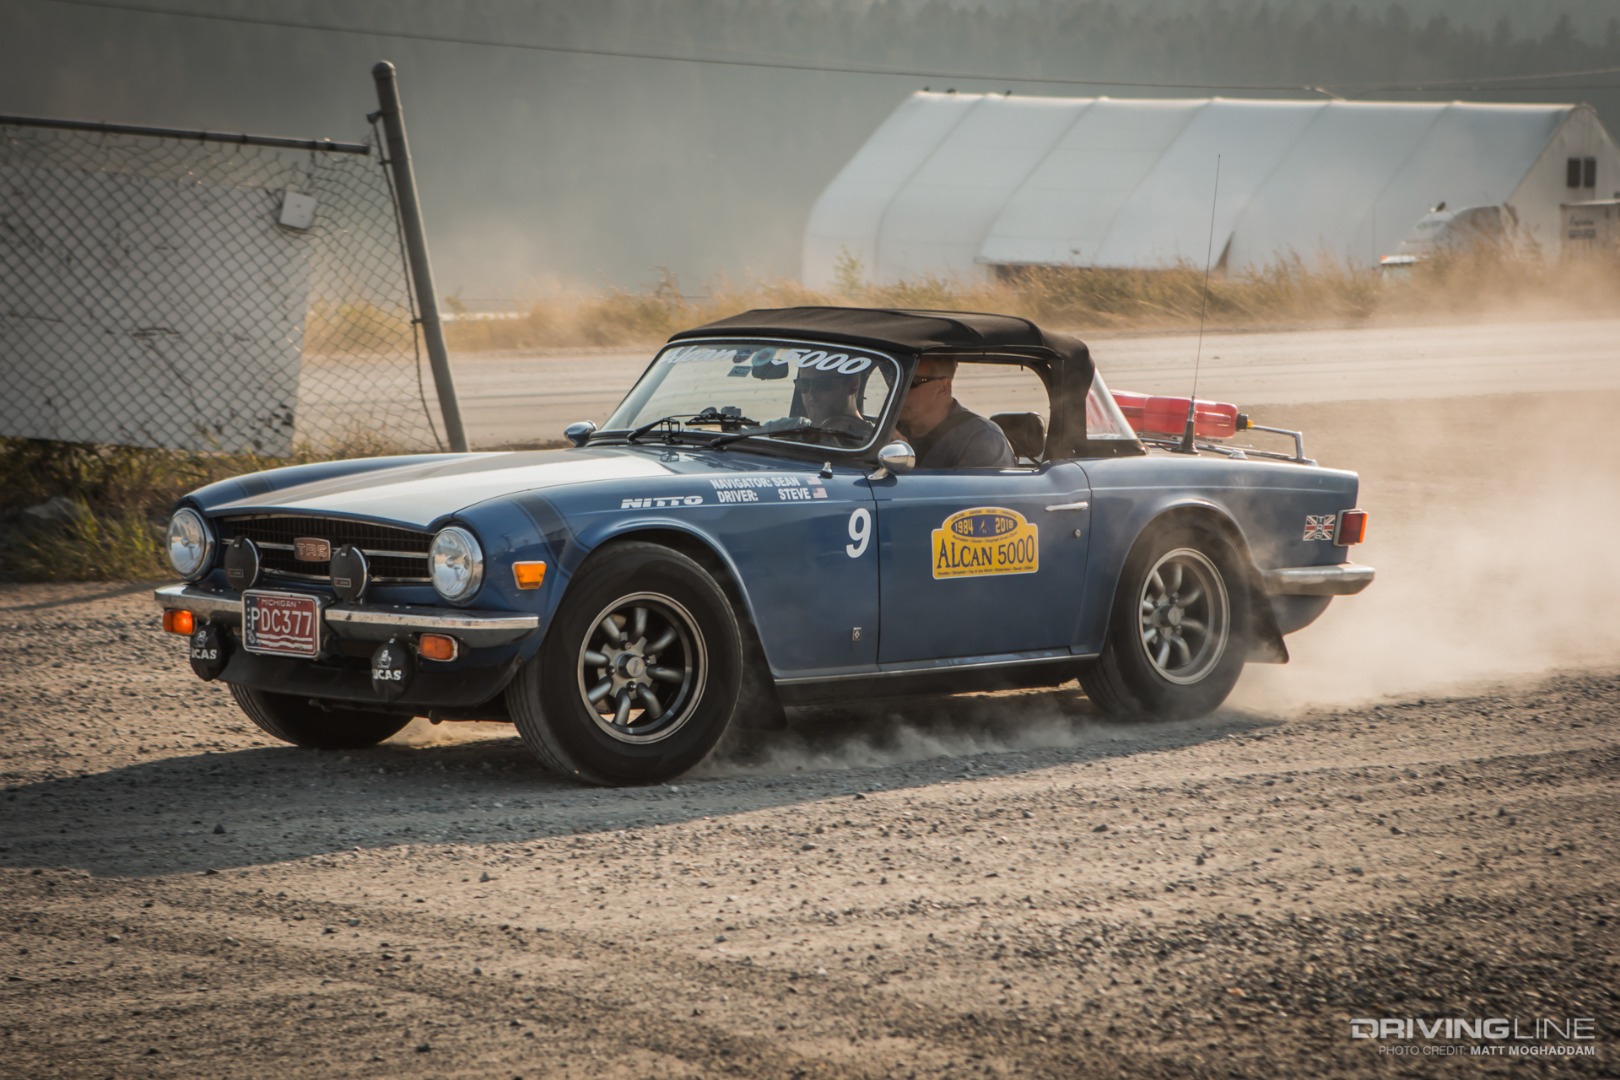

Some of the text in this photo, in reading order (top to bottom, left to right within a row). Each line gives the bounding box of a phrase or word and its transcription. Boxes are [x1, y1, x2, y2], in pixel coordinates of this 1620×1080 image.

[771, 349, 872, 375] 5000
[710, 477, 800, 490] NAVIGATOR: SEAN
[620, 495, 703, 509] NITTO
[716, 488, 811, 503] DRIVER: STEVE
[846, 508, 872, 558] 9
[954, 517, 1014, 535] 1984 2018
[296, 542, 328, 558] TR6
[936, 534, 1035, 569] ALCAN 5000
[261, 599, 297, 608] MICHIGAN
[250, 606, 313, 636] PDC377
[191, 648, 218, 660] CAS
[372, 668, 402, 681] UCAS
